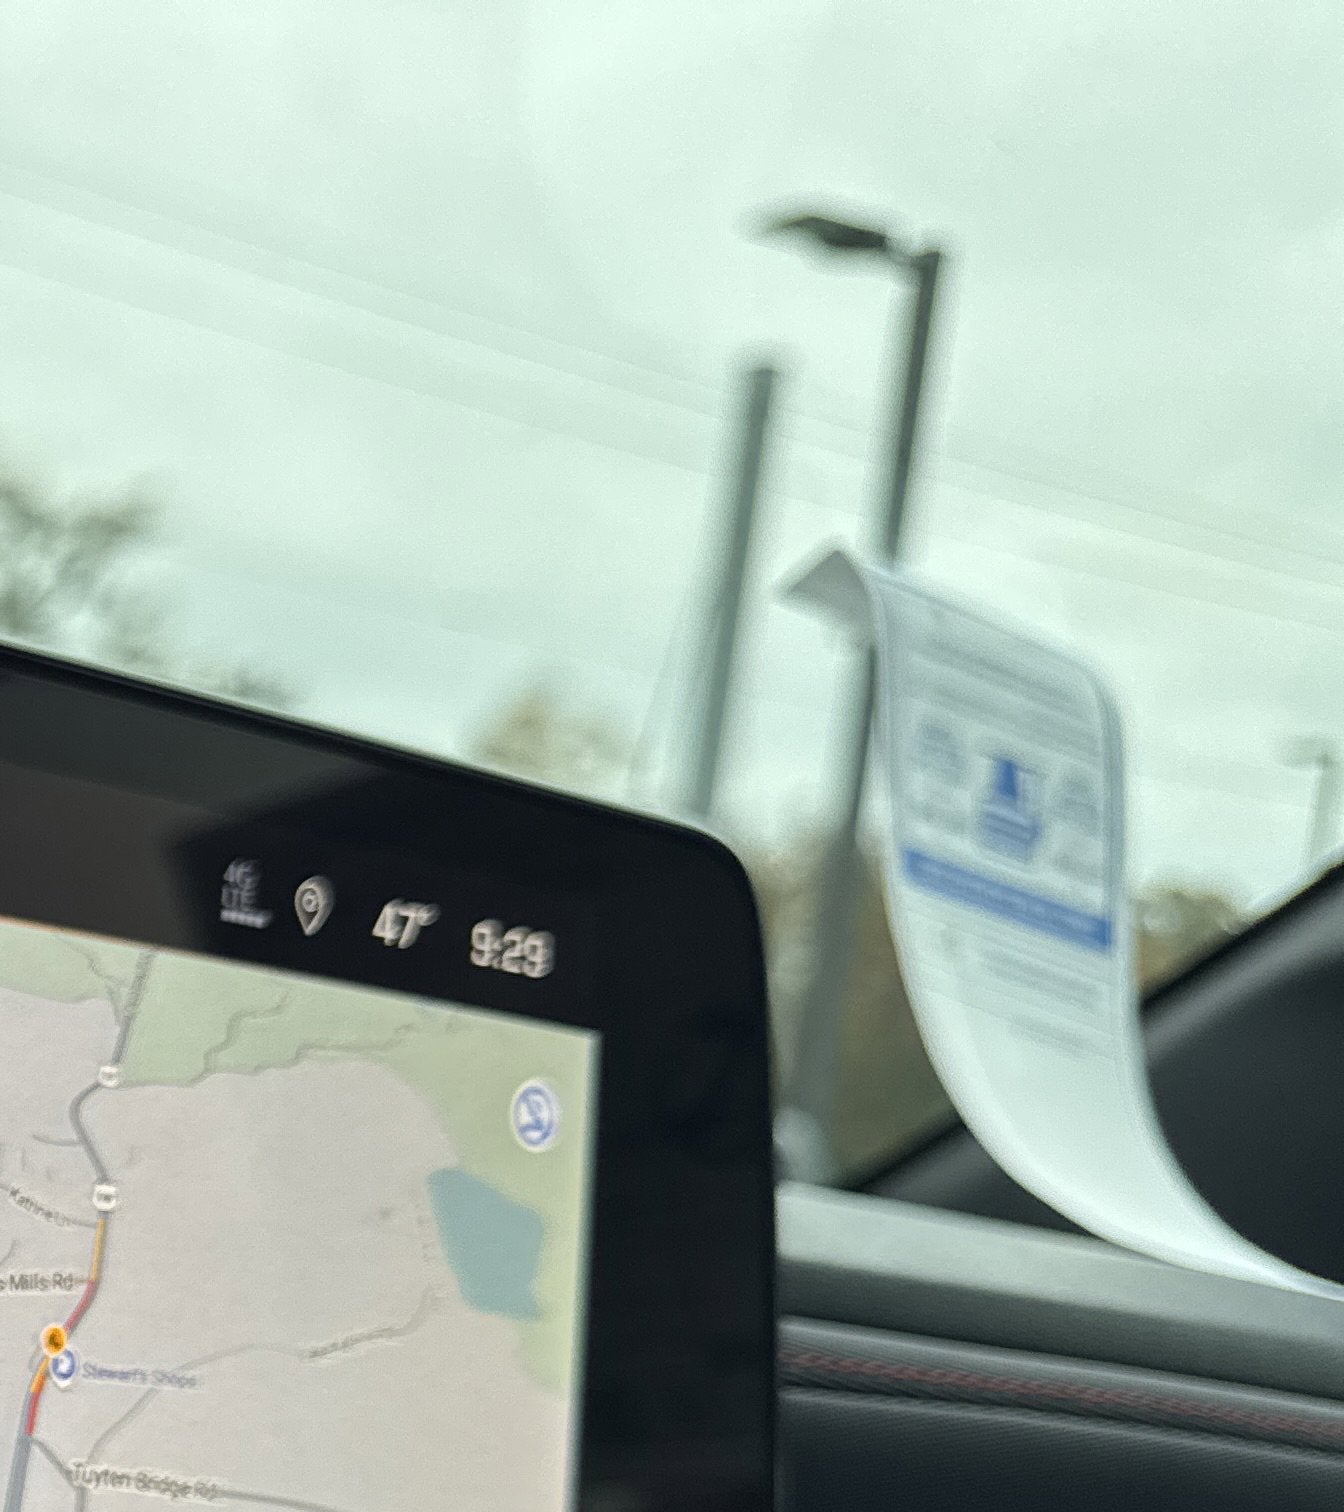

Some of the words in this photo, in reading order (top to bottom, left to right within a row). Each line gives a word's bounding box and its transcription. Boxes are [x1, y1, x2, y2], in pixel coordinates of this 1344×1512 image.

[470, 919, 556, 979] 9:29
[9, 1272, 49, 1291] Mills
[51, 1272, 74, 1290] Rd
